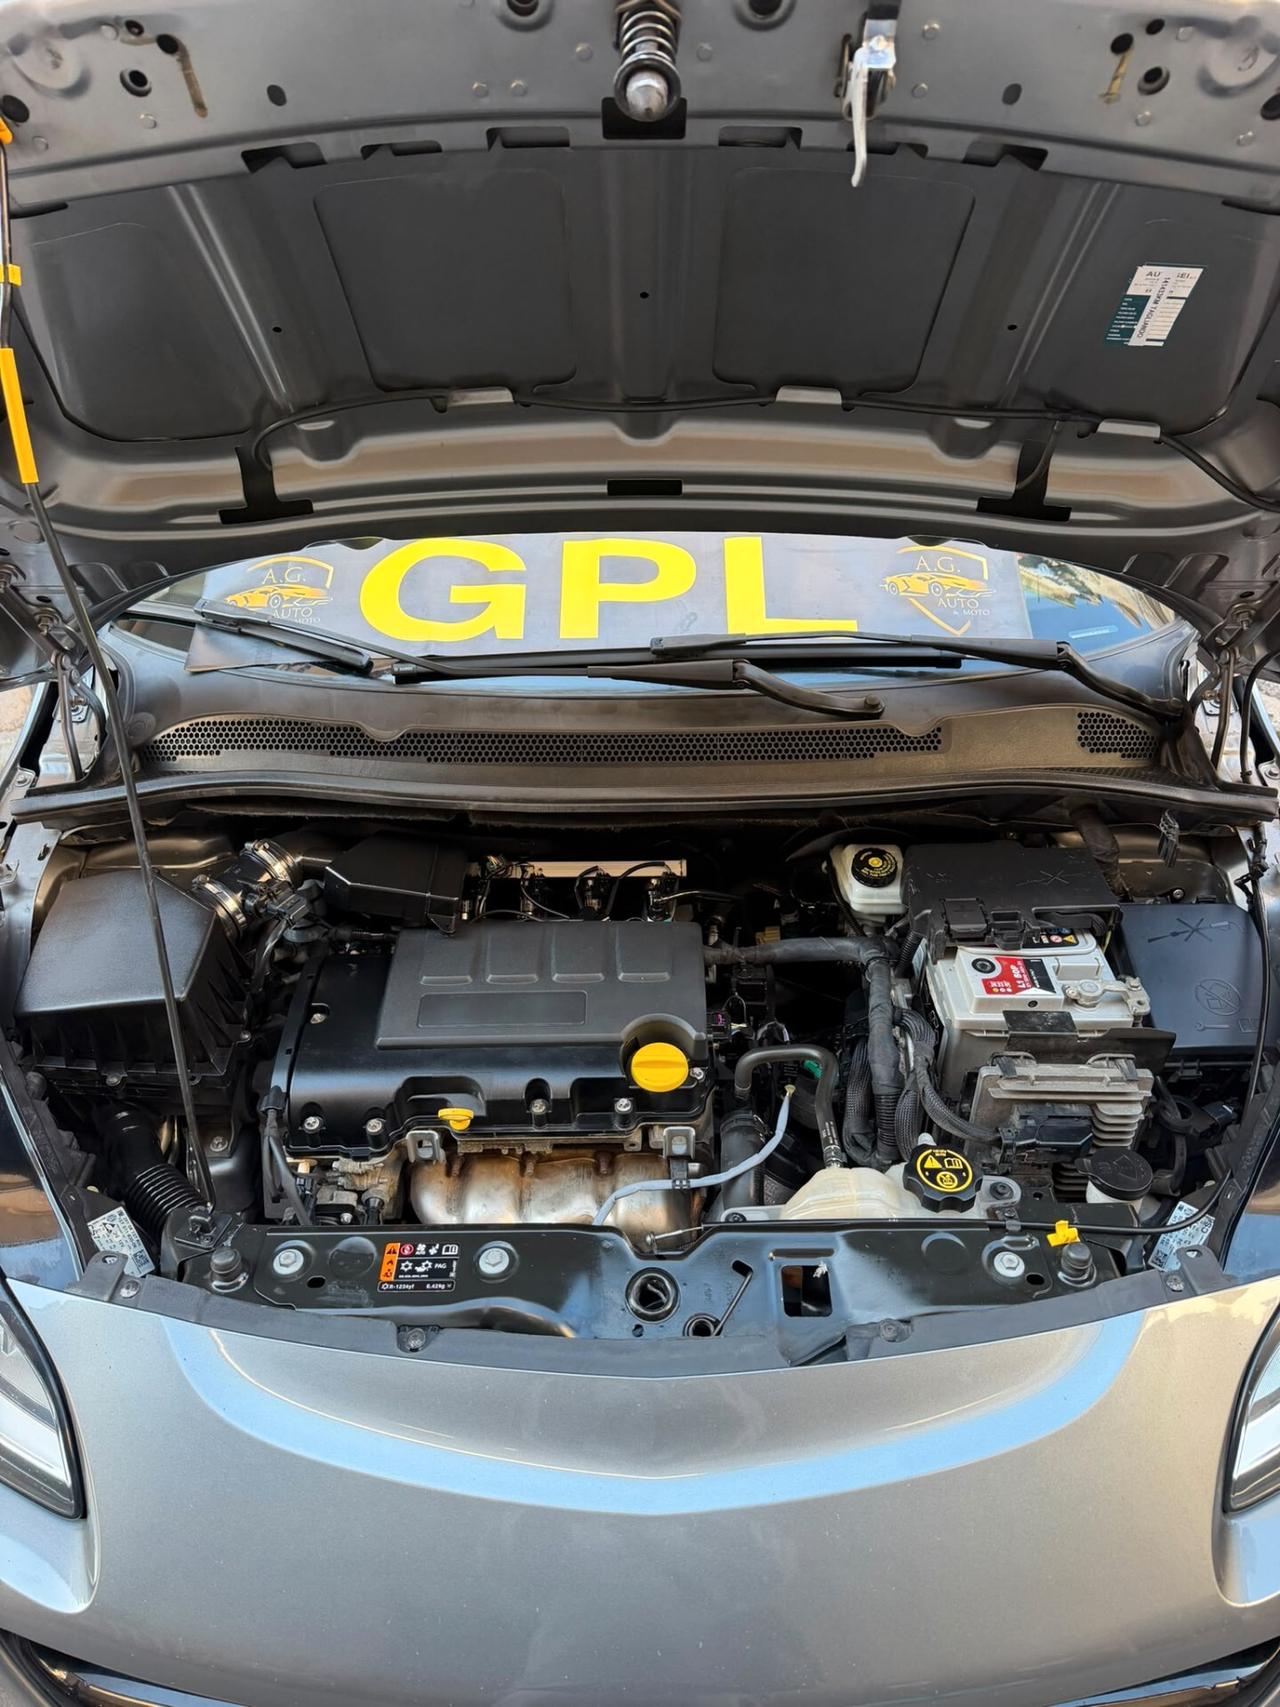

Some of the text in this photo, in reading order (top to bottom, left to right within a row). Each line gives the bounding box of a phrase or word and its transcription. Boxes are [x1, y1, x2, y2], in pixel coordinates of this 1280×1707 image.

[1137, 306, 1157, 338] TAGLIANDO
[360, 536, 858, 642] GPL
[272, 607, 313, 619] AUTO
[937, 598, 979, 609] AUTO
